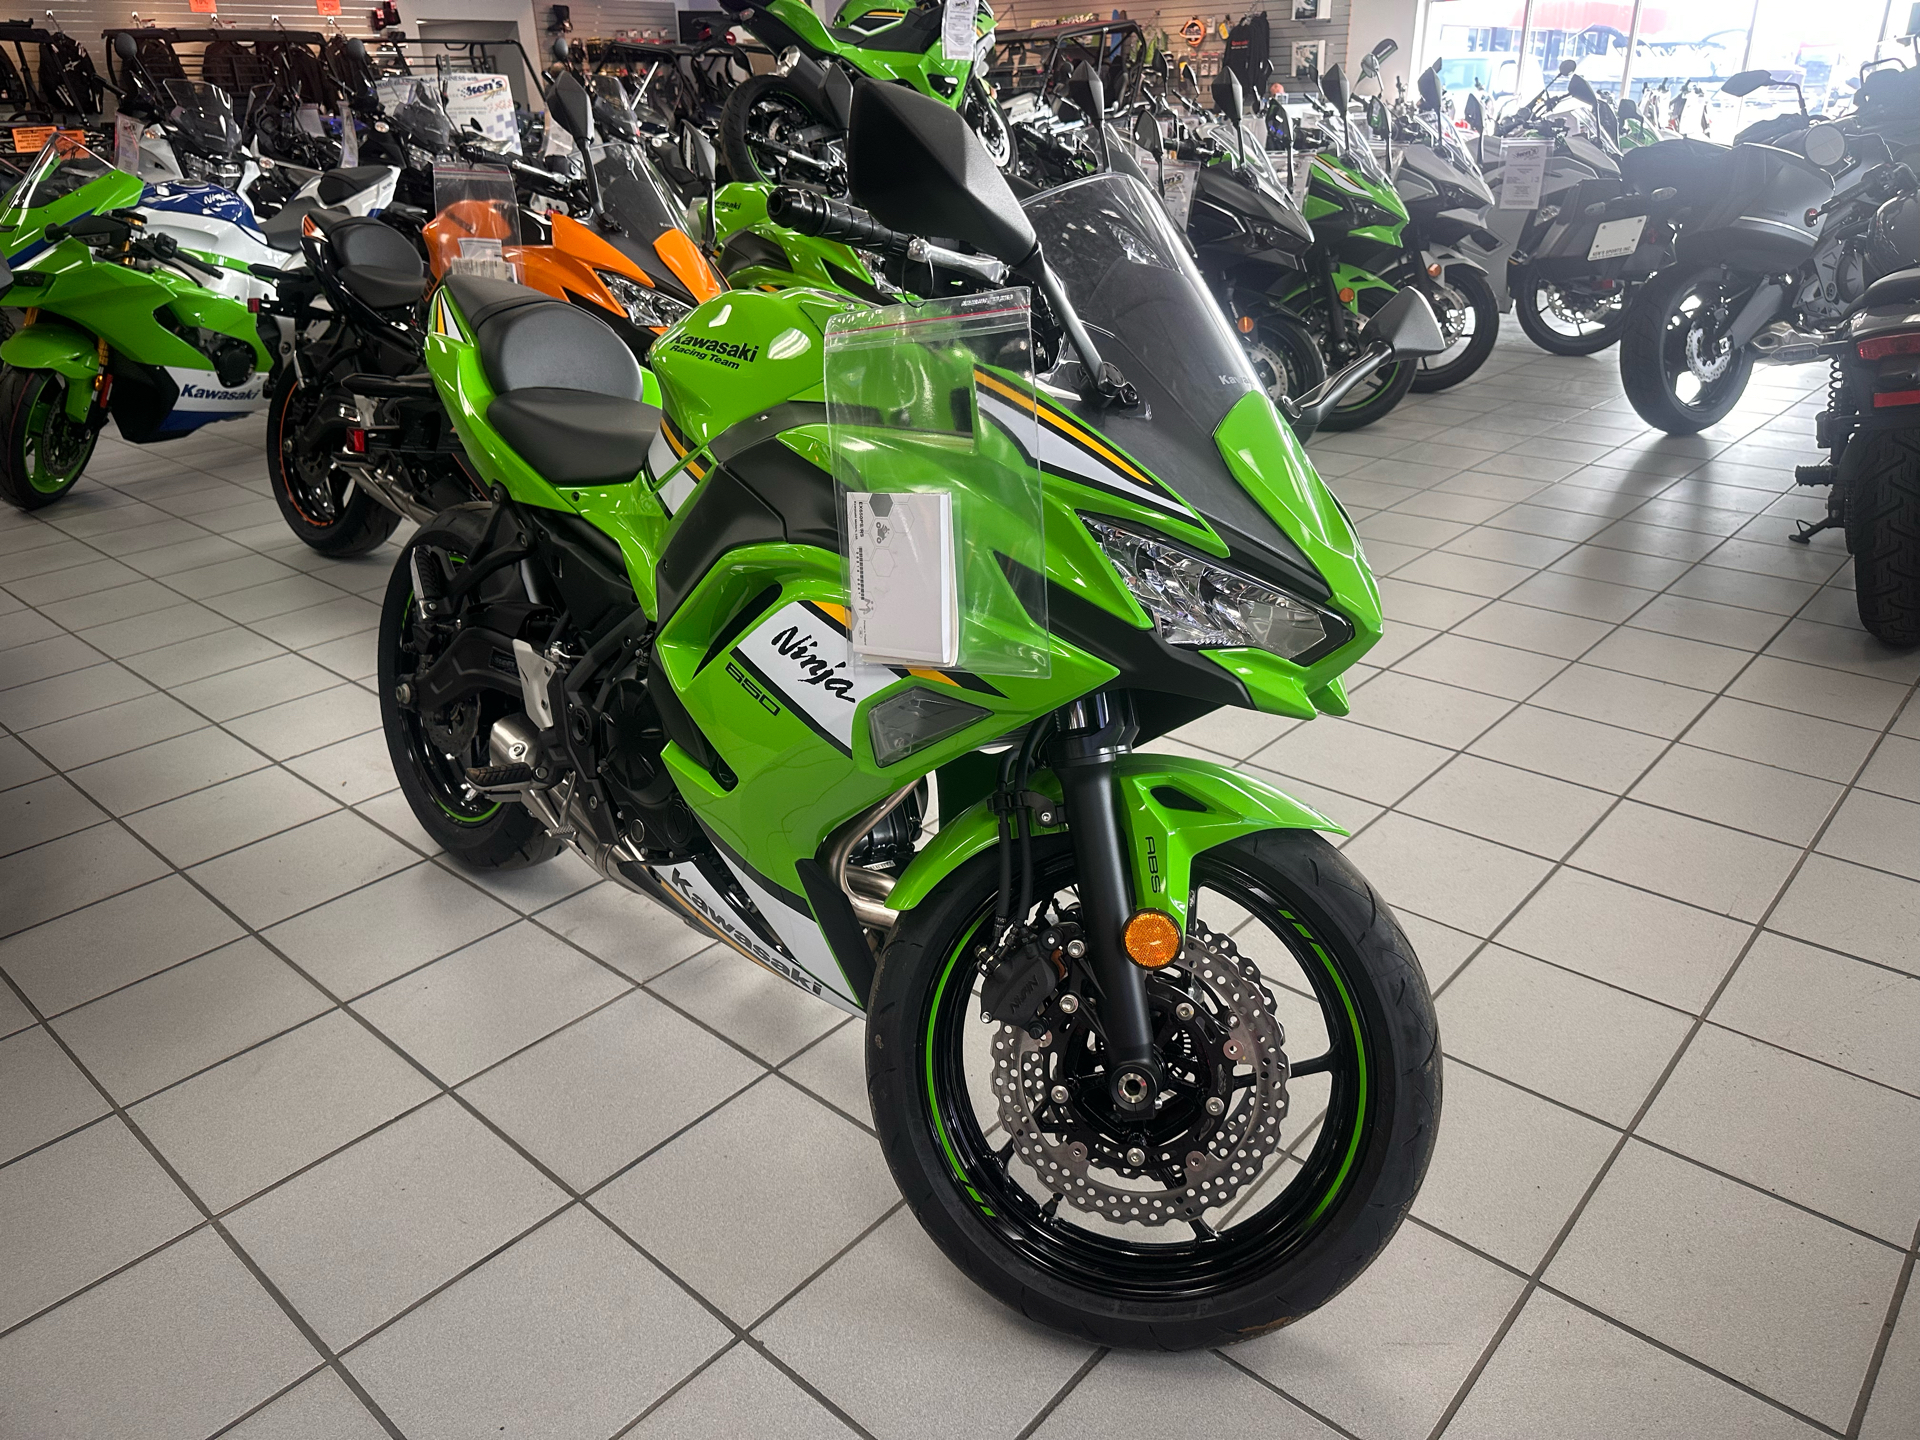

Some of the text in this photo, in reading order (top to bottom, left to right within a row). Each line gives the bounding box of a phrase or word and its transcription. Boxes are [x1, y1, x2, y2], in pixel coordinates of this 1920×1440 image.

[715, 200, 741, 210] wasaki
[669, 345, 740, 370] Racing Team
[670, 333, 760, 363] Kawasaki
[180, 383, 262, 401] Kawasaki
[770, 625, 856, 703] Ninja
[725, 661, 781, 717] 650
[1145, 835, 1161, 894] ABS
[671, 867, 823, 996] Kawasaki
